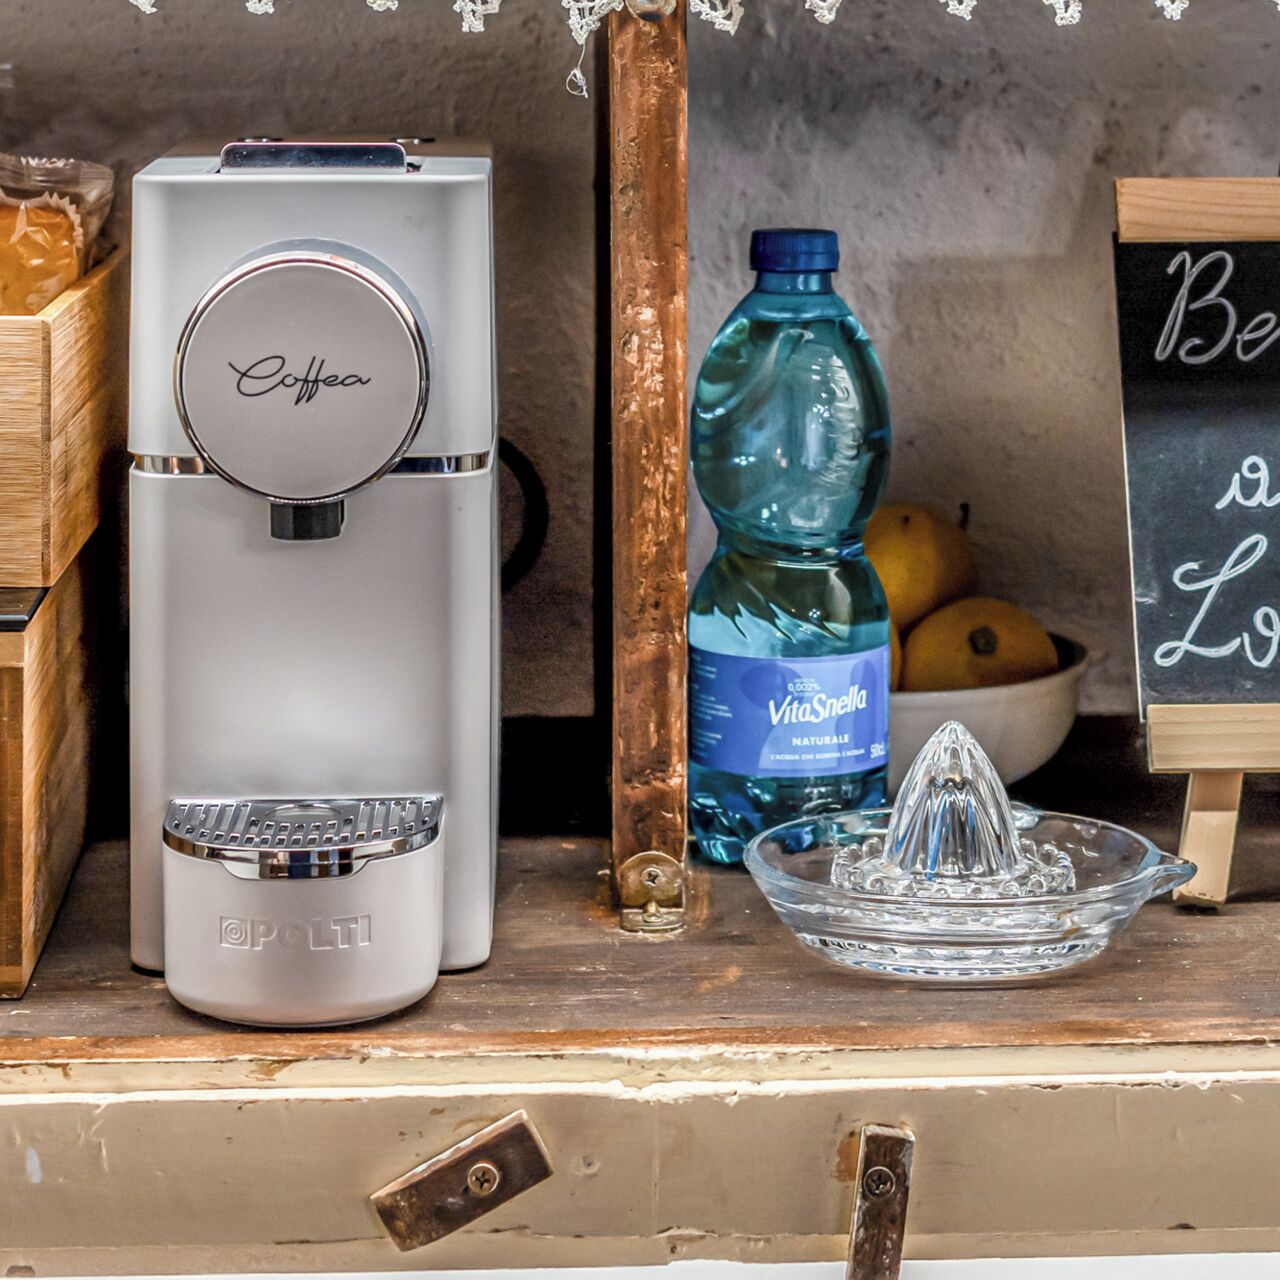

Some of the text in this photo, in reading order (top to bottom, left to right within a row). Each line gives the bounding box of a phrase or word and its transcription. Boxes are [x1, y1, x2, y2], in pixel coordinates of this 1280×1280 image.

[228, 355, 372, 407] Coffea
[792, 734, 849, 746] NATURALE
[250, 914, 371, 950] POLTI
